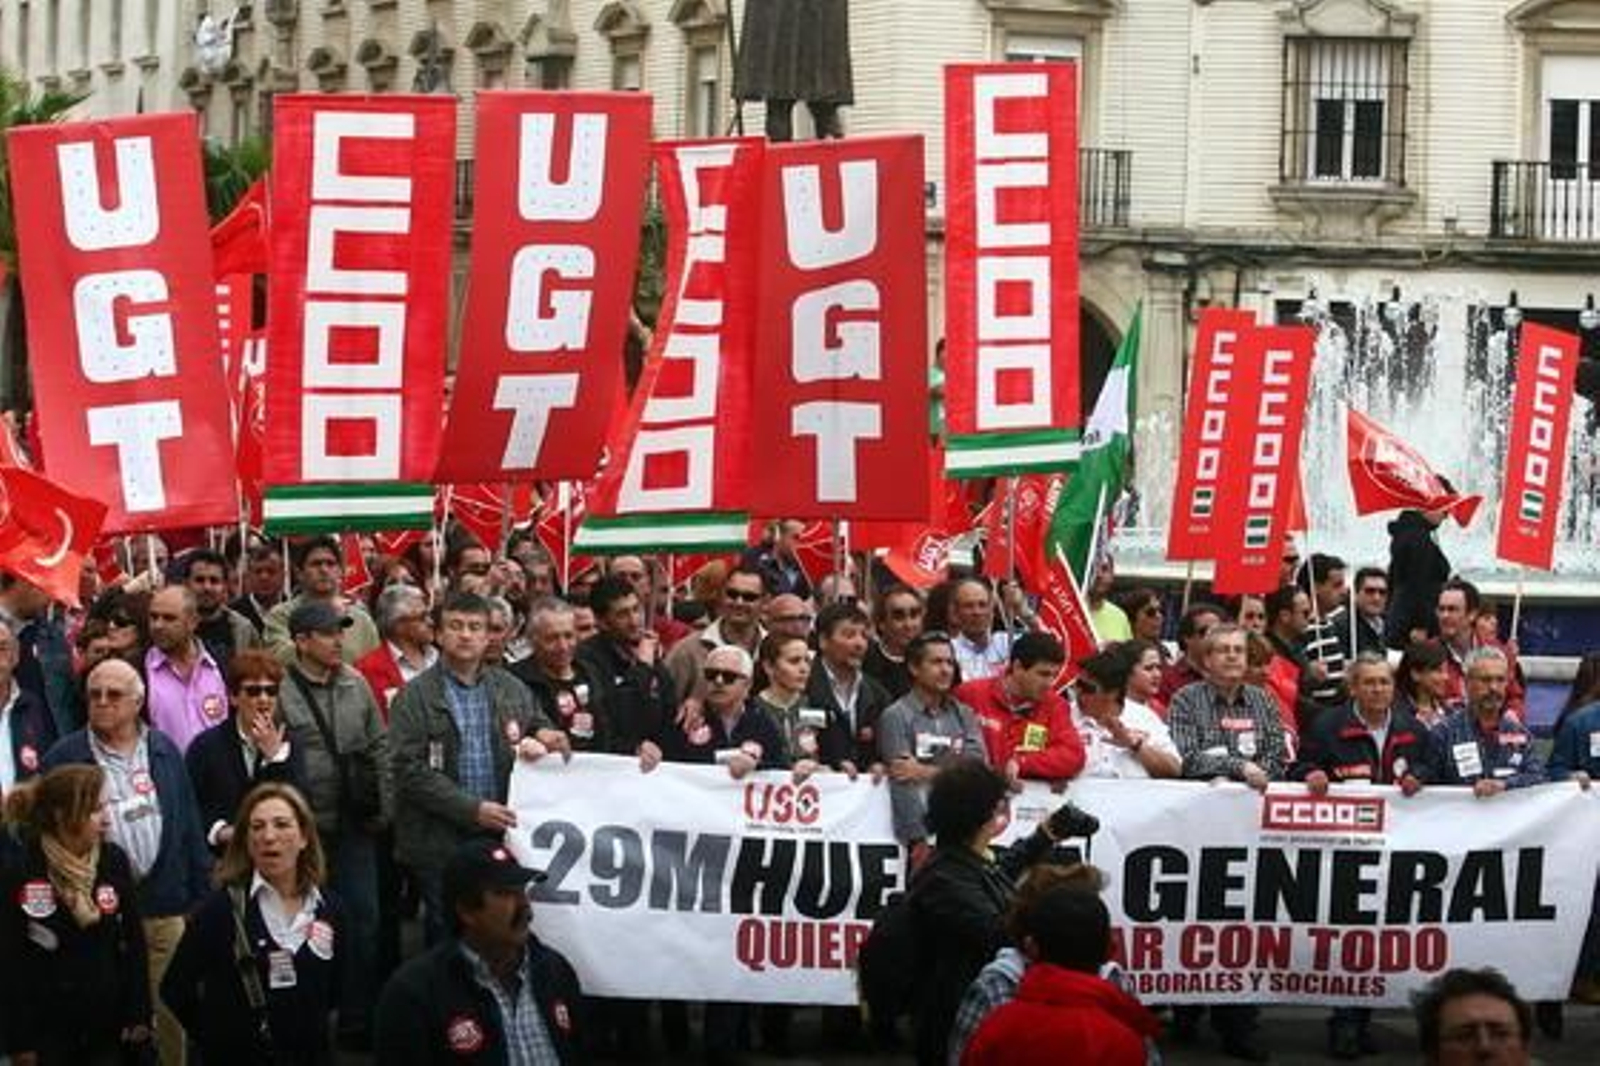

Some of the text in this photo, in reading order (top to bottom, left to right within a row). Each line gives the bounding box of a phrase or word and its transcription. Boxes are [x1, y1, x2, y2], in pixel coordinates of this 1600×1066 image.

[57, 136, 183, 512] UGT
[302, 111, 414, 481] CCOO
[493, 113, 608, 470] UGT
[973, 73, 1052, 430] CCOO
[781, 159, 883, 502] UGT
[1196, 331, 1237, 480] CCOO
[1248, 350, 1294, 508] CCOO
[1523, 345, 1563, 487] CCOO
[744, 783, 820, 824] USC
[1270, 802, 1354, 825] CCOO
[736, 918, 870, 972] QUIER
[1179, 925, 1292, 971] CON
[1308, 926, 1447, 974] TODO
[1123, 845, 1556, 926] GENERAL
[1249, 974, 1263, 994] Y
[1272, 974, 1386, 997] SOCIALES
